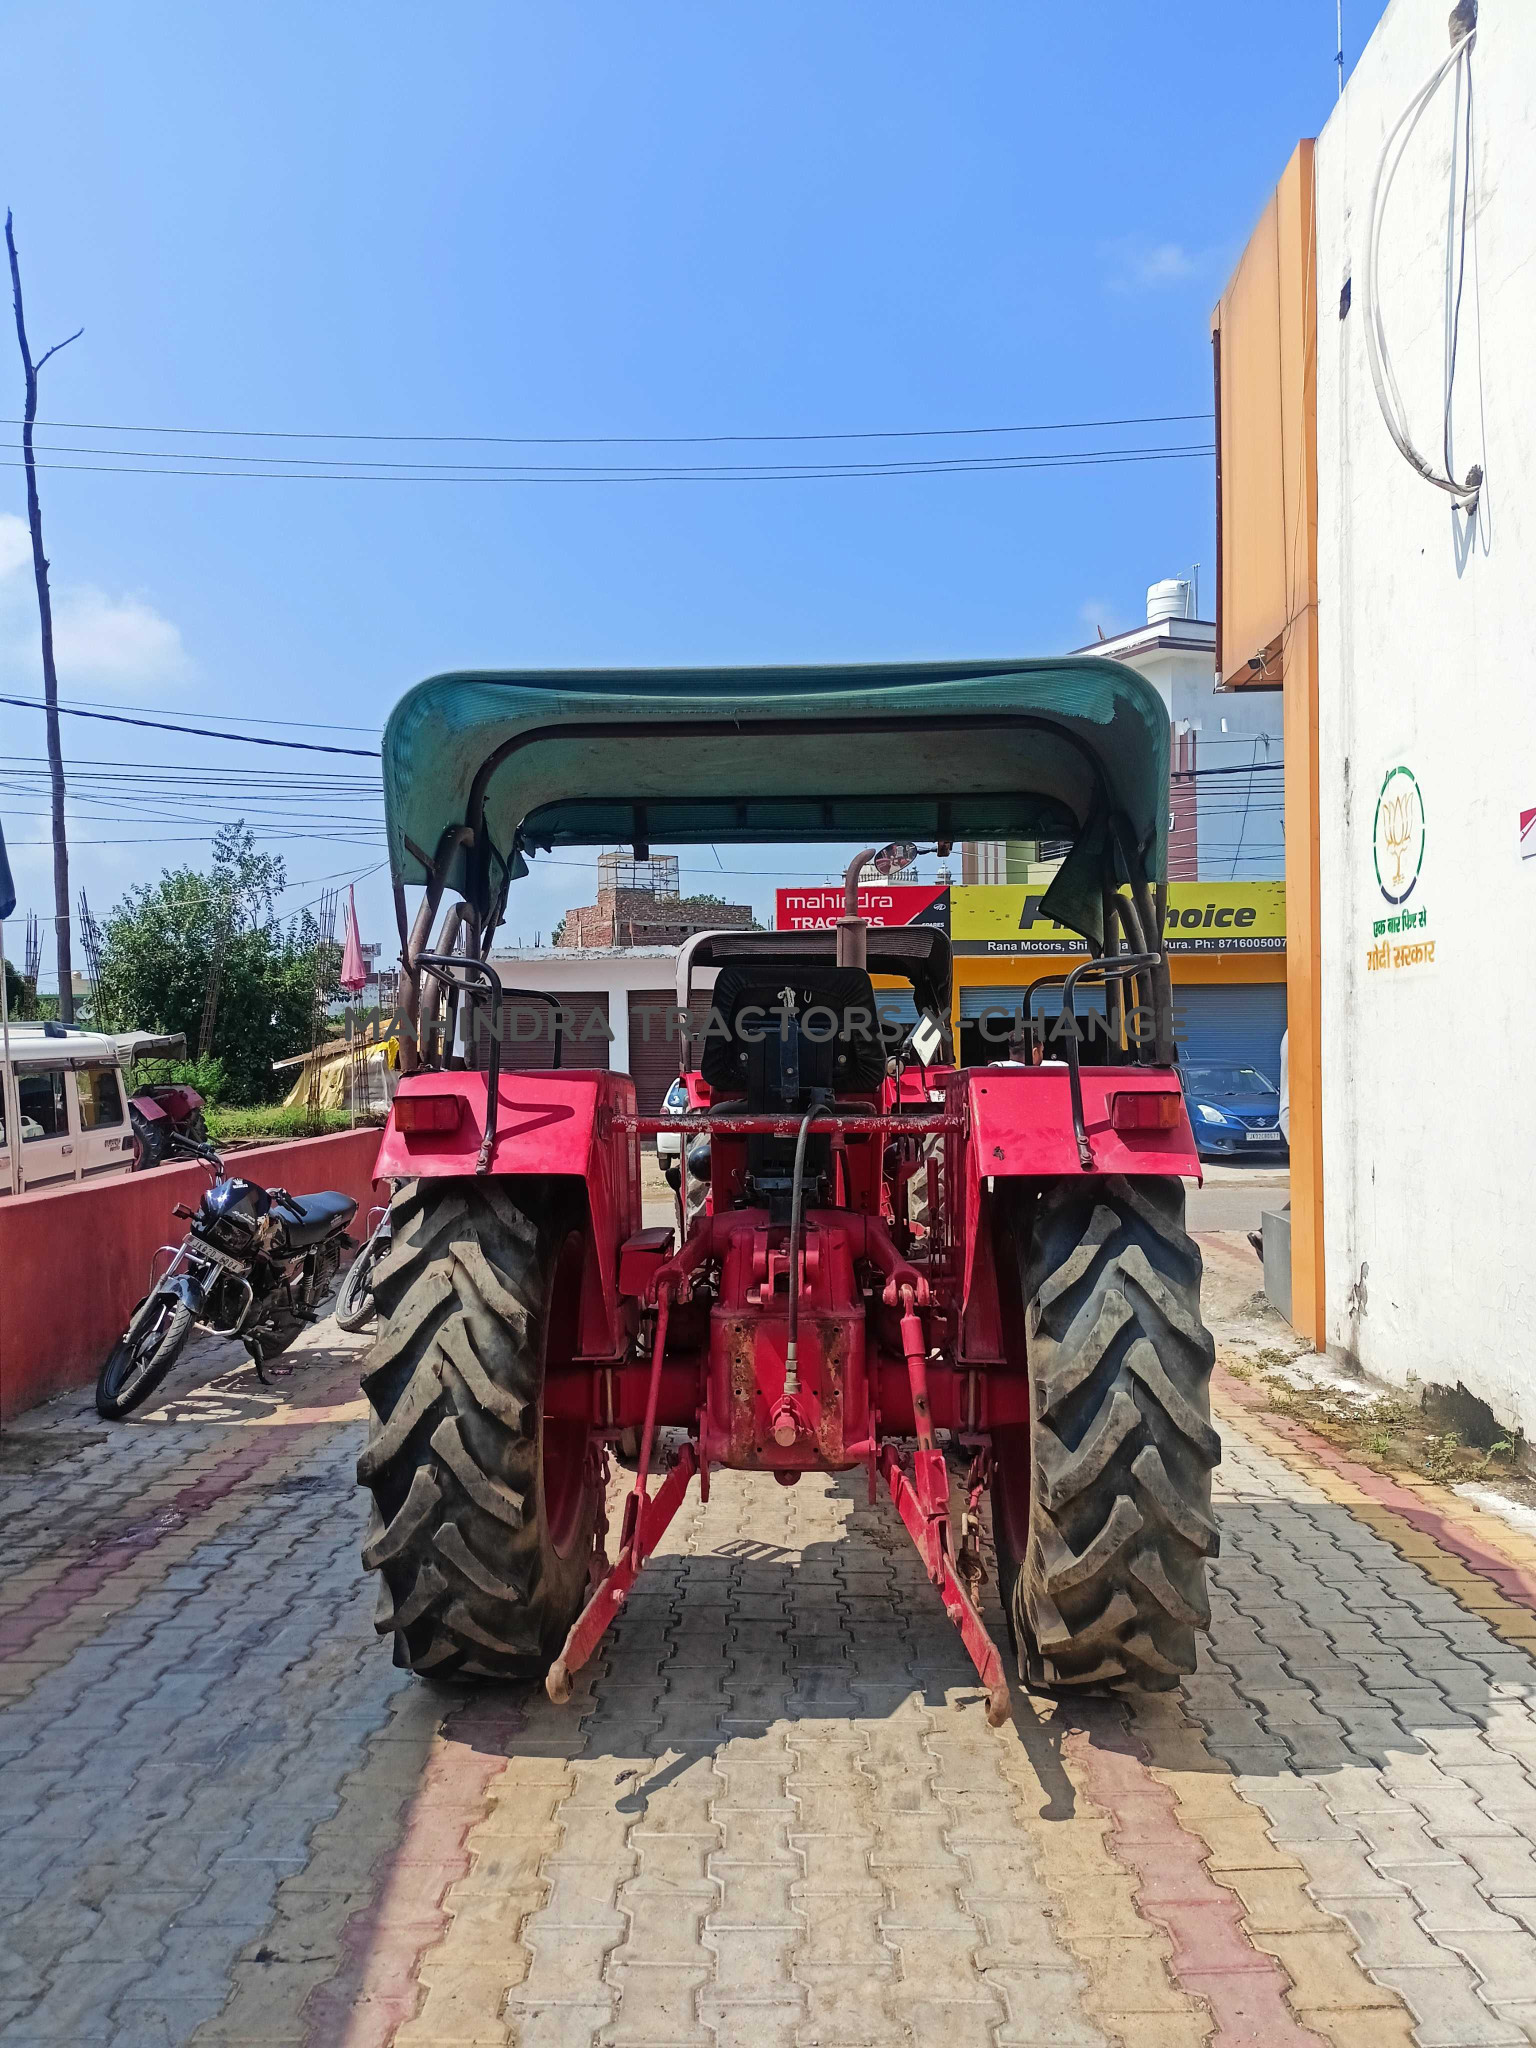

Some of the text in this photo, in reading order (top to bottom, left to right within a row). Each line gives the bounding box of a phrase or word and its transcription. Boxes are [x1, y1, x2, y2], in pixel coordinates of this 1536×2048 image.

[791, 917, 885, 929] TRACRS
[987, 941, 1017, 951] Rana
[1021, 941, 1065, 952] Motors,
[1195, 939, 1215, 949] Ph:
[1218, 938, 1287, 949] 8716005007
[1393, 941, 1436, 968] सरकार
